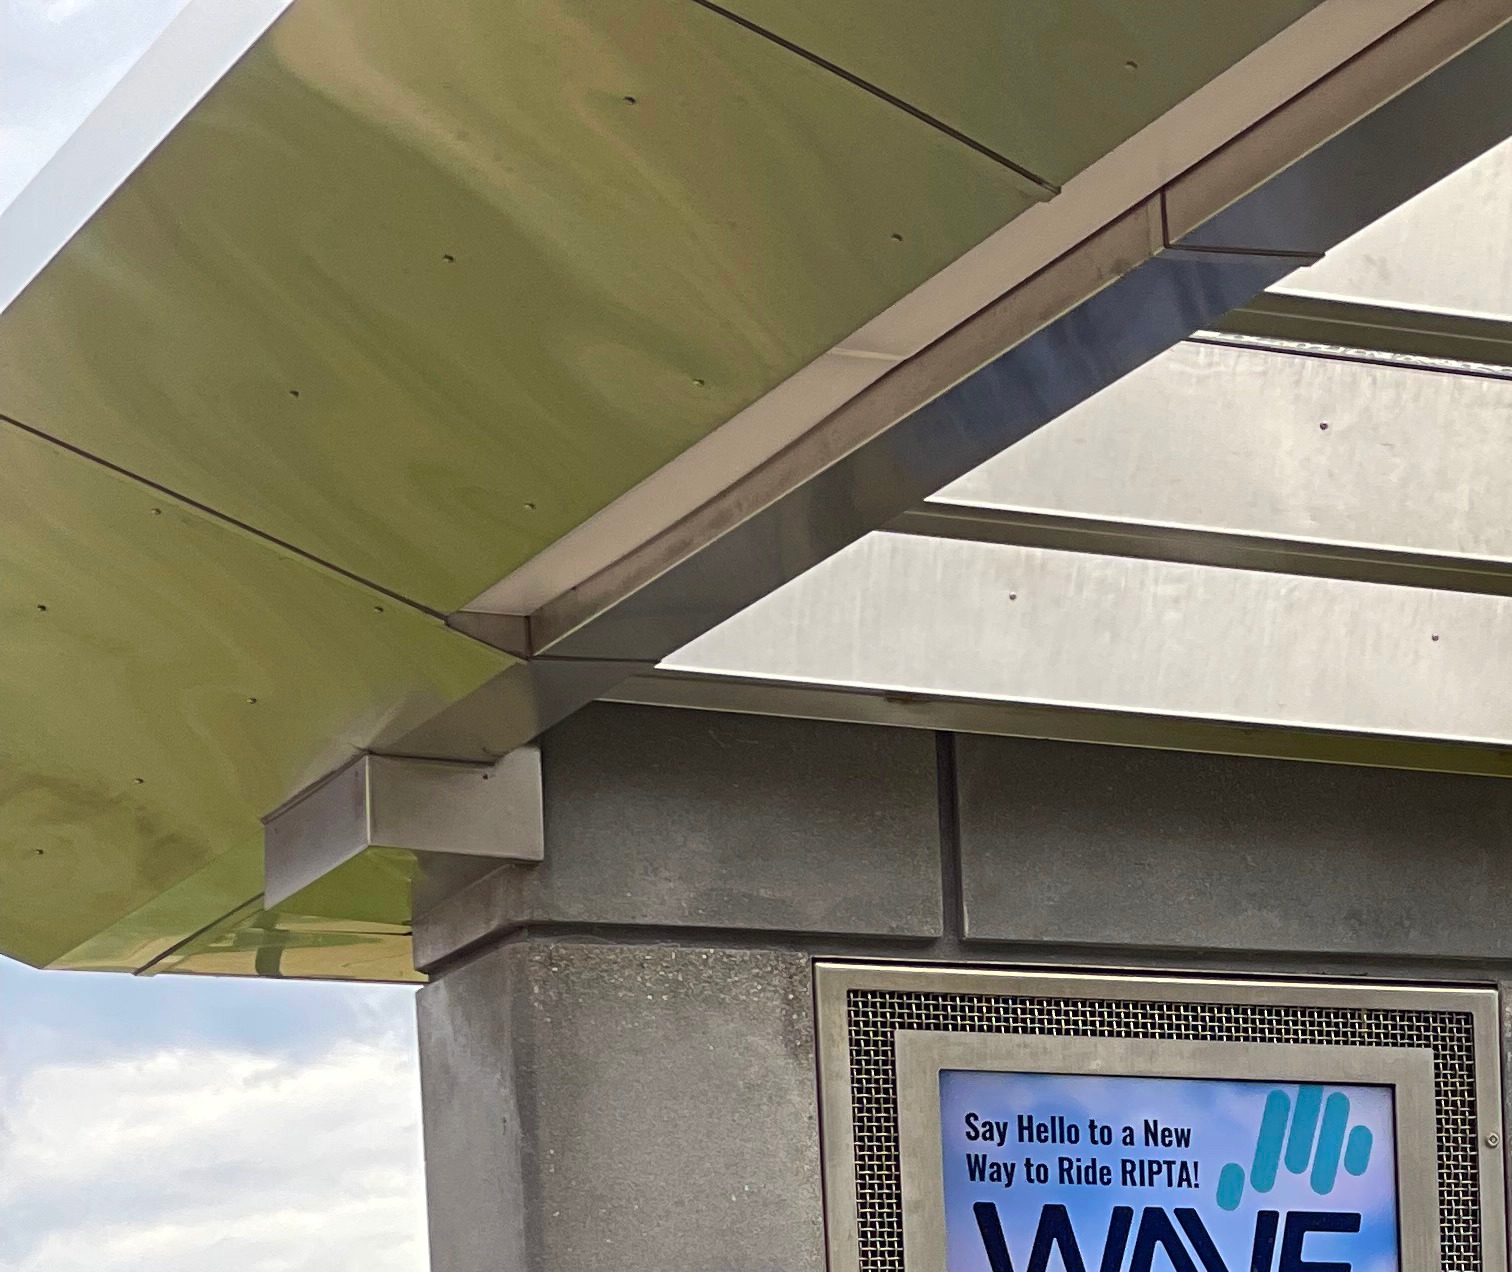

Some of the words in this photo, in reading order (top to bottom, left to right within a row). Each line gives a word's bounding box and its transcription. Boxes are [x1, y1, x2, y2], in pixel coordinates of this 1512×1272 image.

[964, 1113, 1008, 1147] Say
[1017, 1115, 1080, 1145] Hello
[1087, 1120, 1112, 1146] to
[1122, 1125, 1135, 1147] a
[1143, 1120, 1191, 1149] New
[966, 1153, 1016, 1187] Way
[1024, 1157, 1049, 1184] to
[1058, 1157, 1112, 1186] Ride
[1120, 1159, 1199, 1189] RIPTA!
